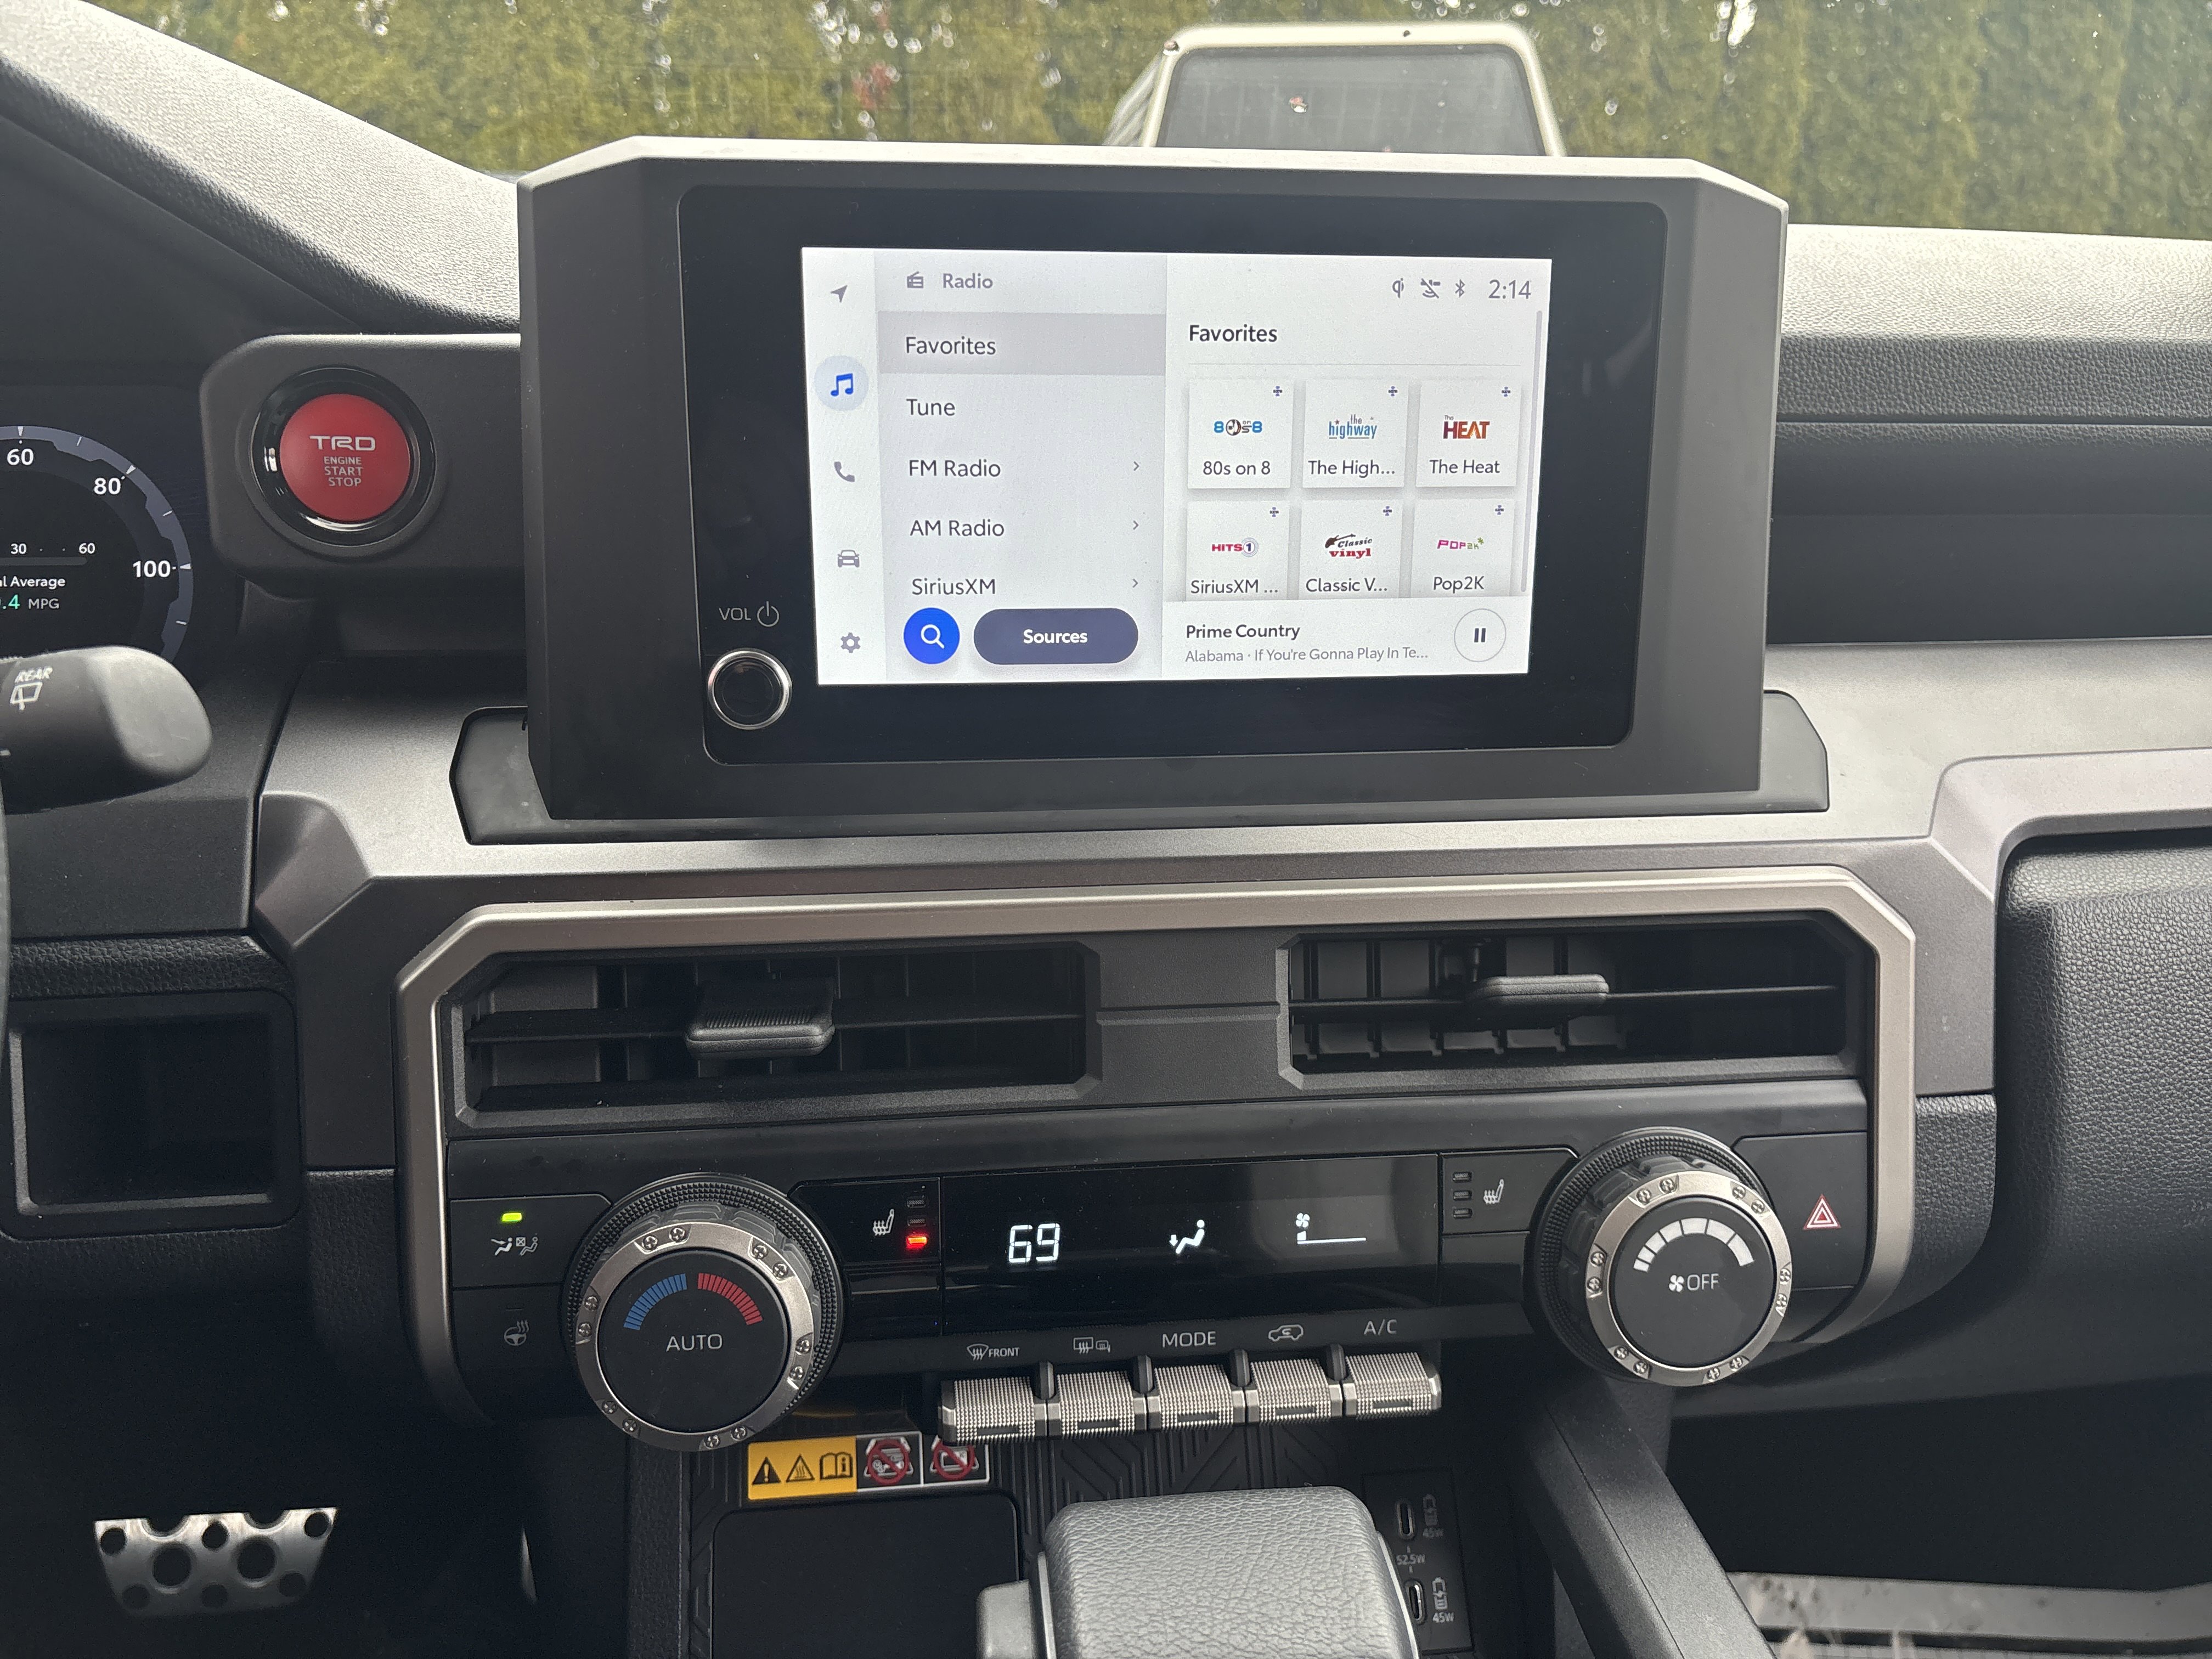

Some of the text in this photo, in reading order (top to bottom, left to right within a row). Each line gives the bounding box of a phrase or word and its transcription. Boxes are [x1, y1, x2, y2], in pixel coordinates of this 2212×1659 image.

[943, 273, 993, 289] Radio
[1488, 279, 1532, 299] 2:14
[1189, 324, 1277, 343] Favorites
[906, 336, 996, 355] Favorites
[907, 399, 956, 416] Tune
[1350, 414, 1362, 424] the
[1329, 421, 1378, 439] highway
[1443, 421, 1490, 439] HEAT
[309, 435, 376, 451] TRD
[7, 448, 34, 466] 60
[324, 456, 362, 465] ENGINE
[324, 466, 363, 476] START
[909, 459, 1001, 477] FM Radio
[1203, 461, 1271, 476] 80s on 8
[1308, 460, 1396, 478] The High...
[1429, 459, 1500, 474] The Heat
[94, 477, 121, 495] 80
[328, 477, 362, 487] STOP
[910, 518, 1005, 537] AM Radio
[10, 543, 95, 555] 30 60
[1337, 537, 1373, 548] Classic
[1329, 548, 1372, 559] vinyl
[132, 560, 171, 578] 100
[10, 575, 66, 589] Average
[911, 578, 996, 596] SiriusXM
[1190, 579, 1259, 594] SiriusXM
[1306, 578, 1388, 593] Classic V...
[1433, 576, 1485, 595] Pop2K
[29, 598, 60, 610] MPG
[719, 607, 752, 621] VOL
[1023, 629, 1088, 645] Sources
[1186, 623, 1300, 641] Prime Country
[1185, 646, 1429, 663] Alabama If You're Gonna Play In Te...
[15, 665, 53, 684] REAR
[1008, 1223, 1060, 1264] 69
[1687, 1273, 1720, 1291] OFF
[1364, 1319, 1397, 1336] A/C
[665, 1333, 723, 1352] AUTO
[1162, 1331, 1217, 1348] MODE
[989, 1347, 1019, 1358] FRONT
[1432, 1612, 1455, 1624] 45W
